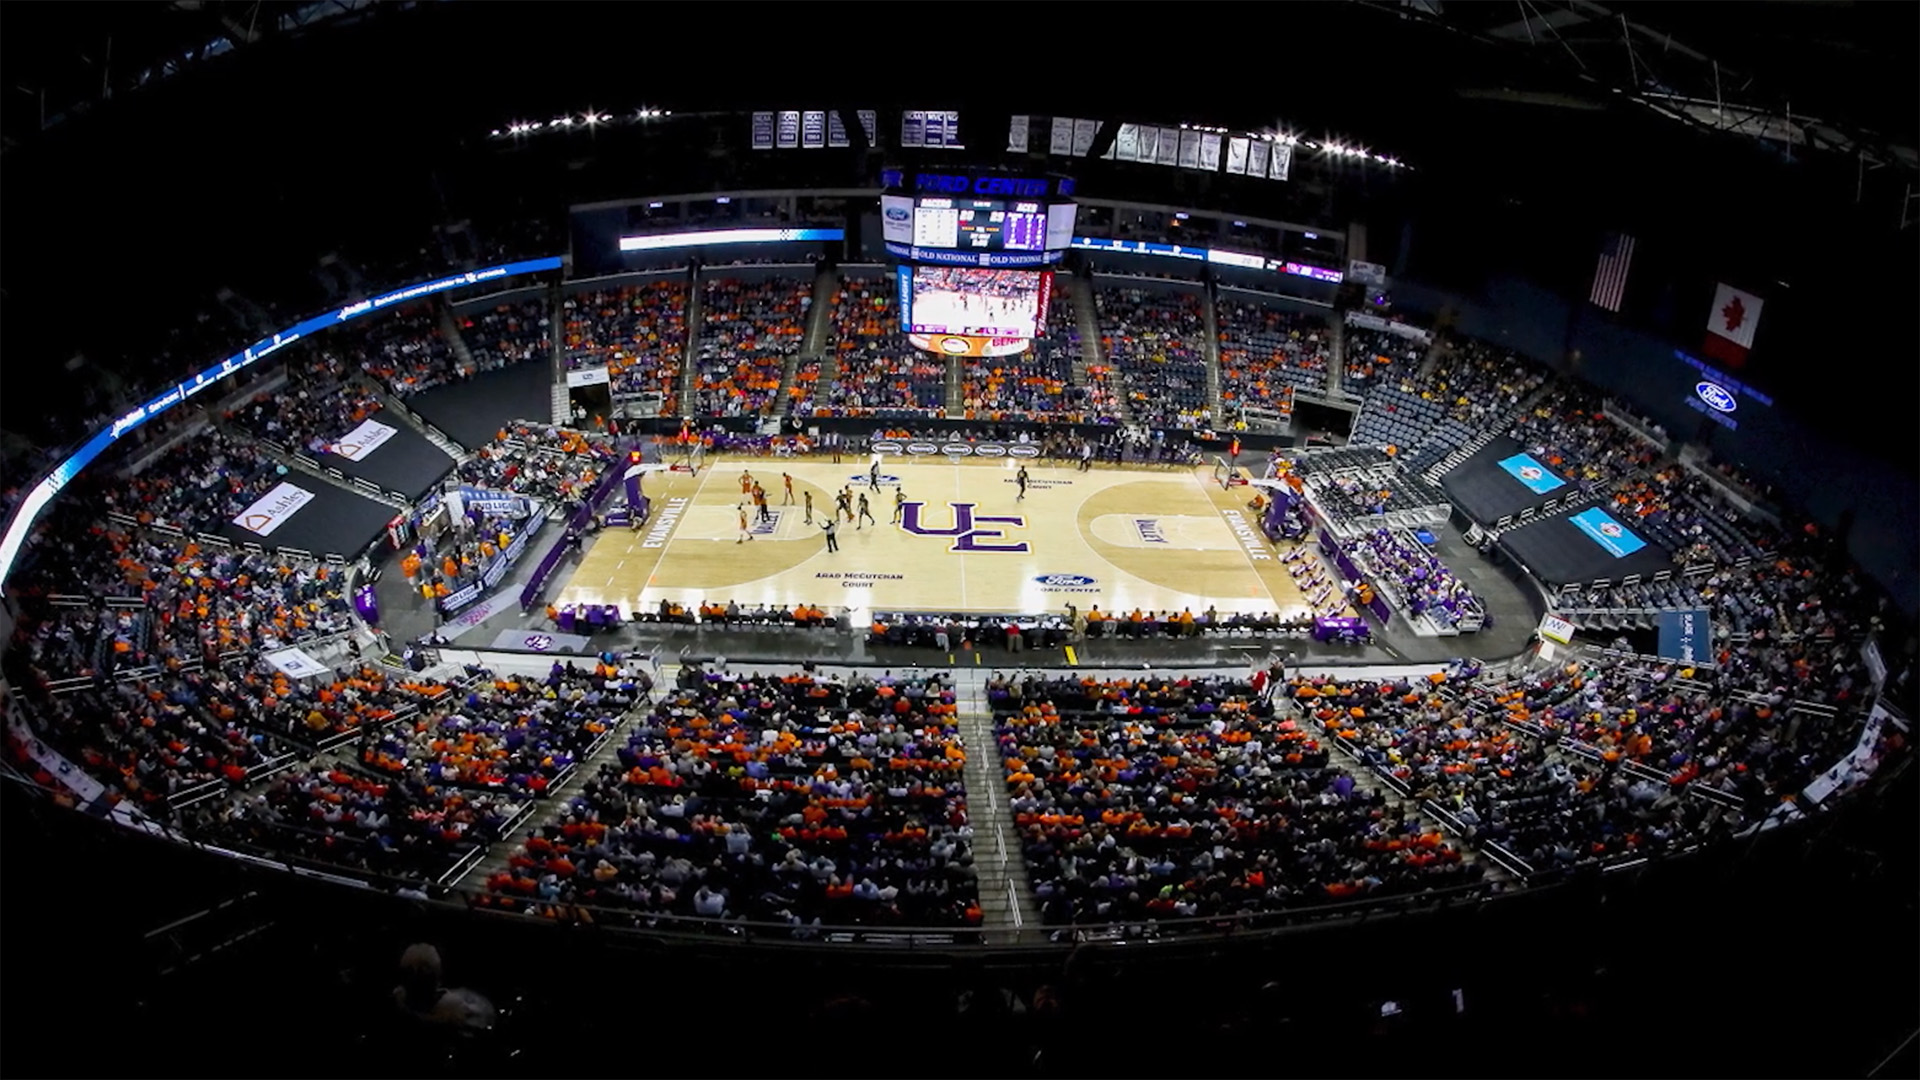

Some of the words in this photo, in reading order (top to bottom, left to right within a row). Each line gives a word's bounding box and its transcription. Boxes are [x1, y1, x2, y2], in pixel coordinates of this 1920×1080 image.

[919, 251, 935, 260] OLD
[936, 253, 977, 264] NATIONAL
[1010, 256, 1041, 264] NATIONAL
[1702, 385, 1730, 409] Ford
[356, 427, 390, 448] Ashley
[267, 489, 307, 517] Ashley
[642, 497, 688, 548] EVANSVILLE
[899, 501, 1032, 553] UE
[1222, 509, 1271, 560] EVANSVILLE
[1046, 575, 1085, 586] Ford
